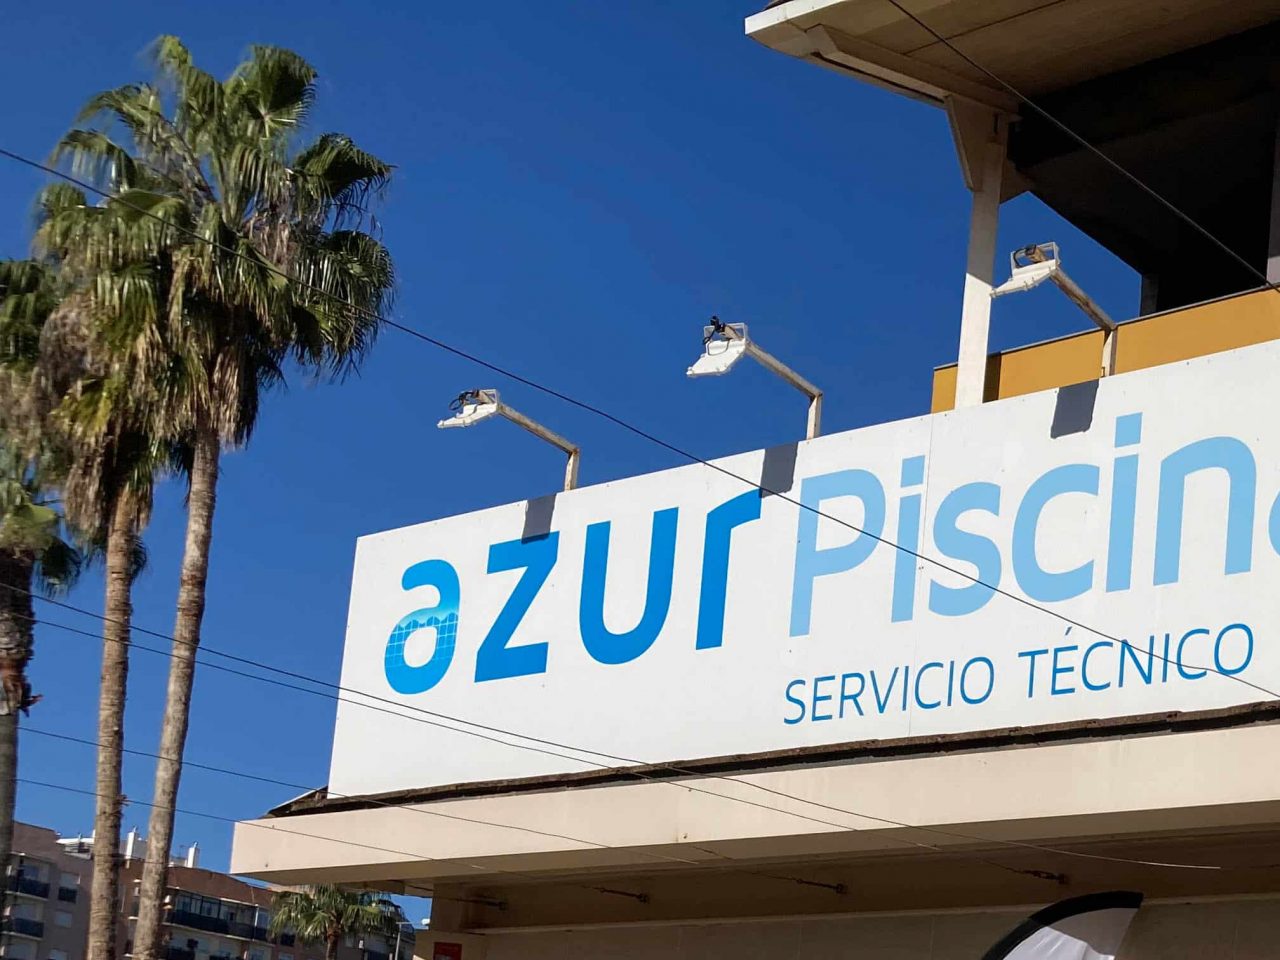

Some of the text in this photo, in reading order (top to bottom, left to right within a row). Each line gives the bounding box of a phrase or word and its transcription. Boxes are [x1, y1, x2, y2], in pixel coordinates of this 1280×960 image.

[384, 487, 763, 695] azur
[783, 655, 996, 725] SERVICIO
[1018, 622, 1254, 700] TÉCNICO
